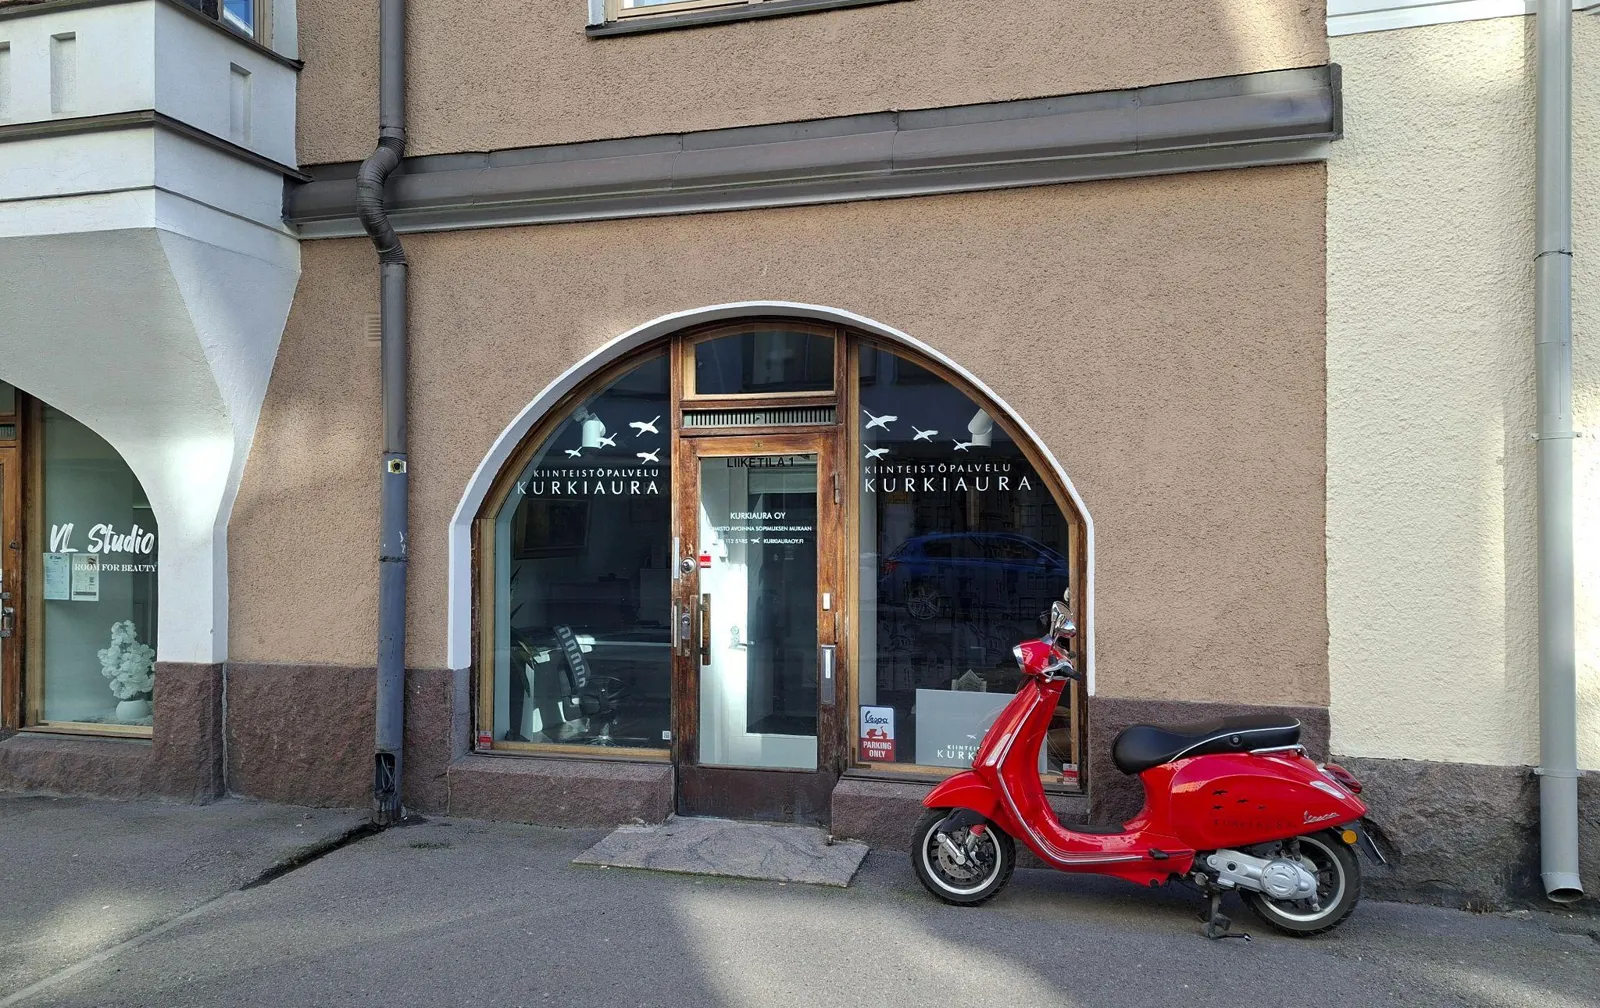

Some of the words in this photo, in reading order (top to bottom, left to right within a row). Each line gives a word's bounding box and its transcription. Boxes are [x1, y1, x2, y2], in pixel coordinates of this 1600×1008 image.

[727, 457, 785, 468] LIIKETILA
[789, 456, 794, 467] 1
[533, 468, 659, 478] KIINTEISTÖPALVELU
[865, 463, 1011, 474] KIINTEISTÖPALVELU
[517, 480, 659, 495] KURKIAURA
[865, 476, 1032, 493] KURKIAURA
[730, 512, 772, 520] KURKIAURA
[87, 523, 155, 554] Studio
[75, 564, 100, 572] ROOM
[102, 564, 119, 572] FOR
[121, 564, 157, 573] BEAUTY
[864, 710, 889, 724] Vespa
[863, 741, 892, 750] PARKING
[869, 750, 886, 758] ONLY
